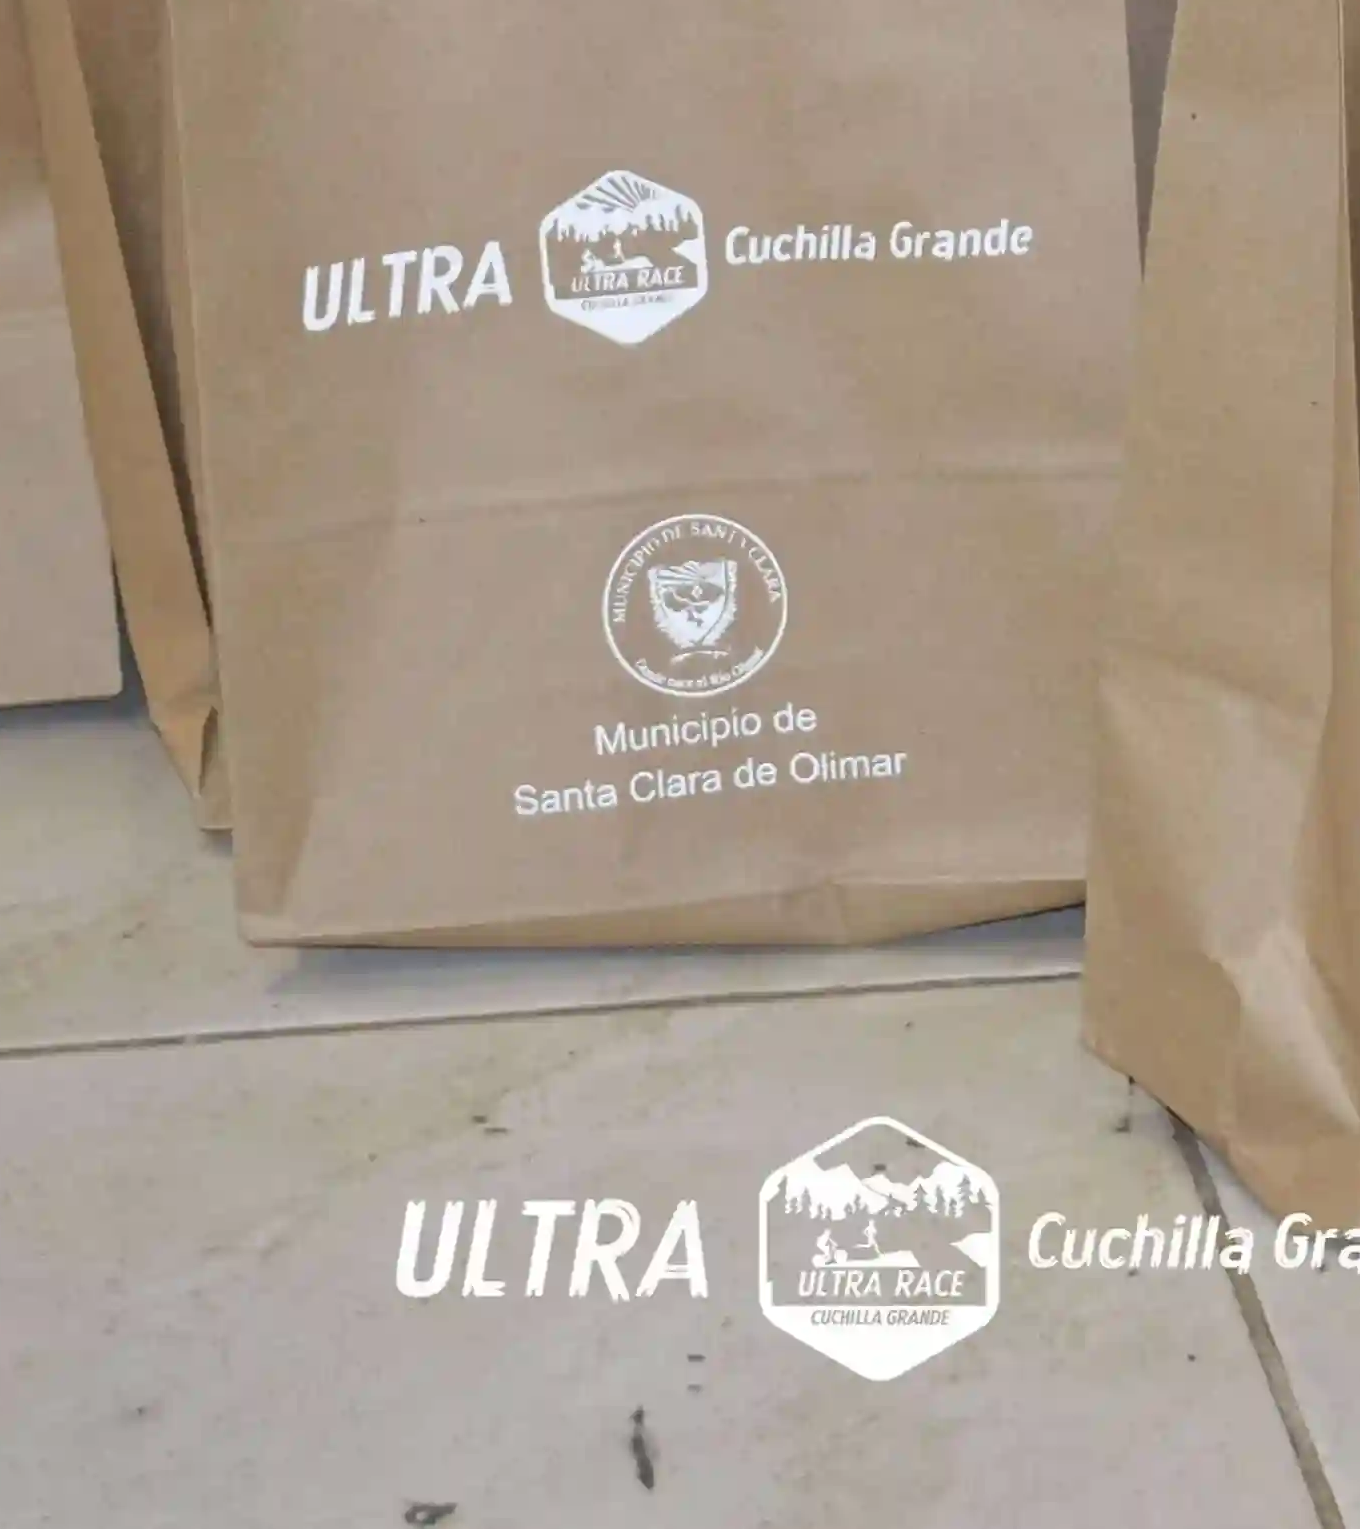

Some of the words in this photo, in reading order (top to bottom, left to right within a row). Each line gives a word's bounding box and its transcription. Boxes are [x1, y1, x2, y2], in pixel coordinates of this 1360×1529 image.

[302, 240, 514, 332] ULTRA
[724, 224, 877, 266] Cuchilla
[889, 218, 1034, 261] Grande
[570, 271, 629, 293] ULTRA
[636, 265, 686, 288] RACE
[593, 707, 762, 756] Municipio
[772, 702, 817, 734] de
[513, 779, 618, 816] Santa
[629, 769, 722, 803] Clara
[733, 757, 778, 789] de
[789, 751, 907, 784] Olimar
